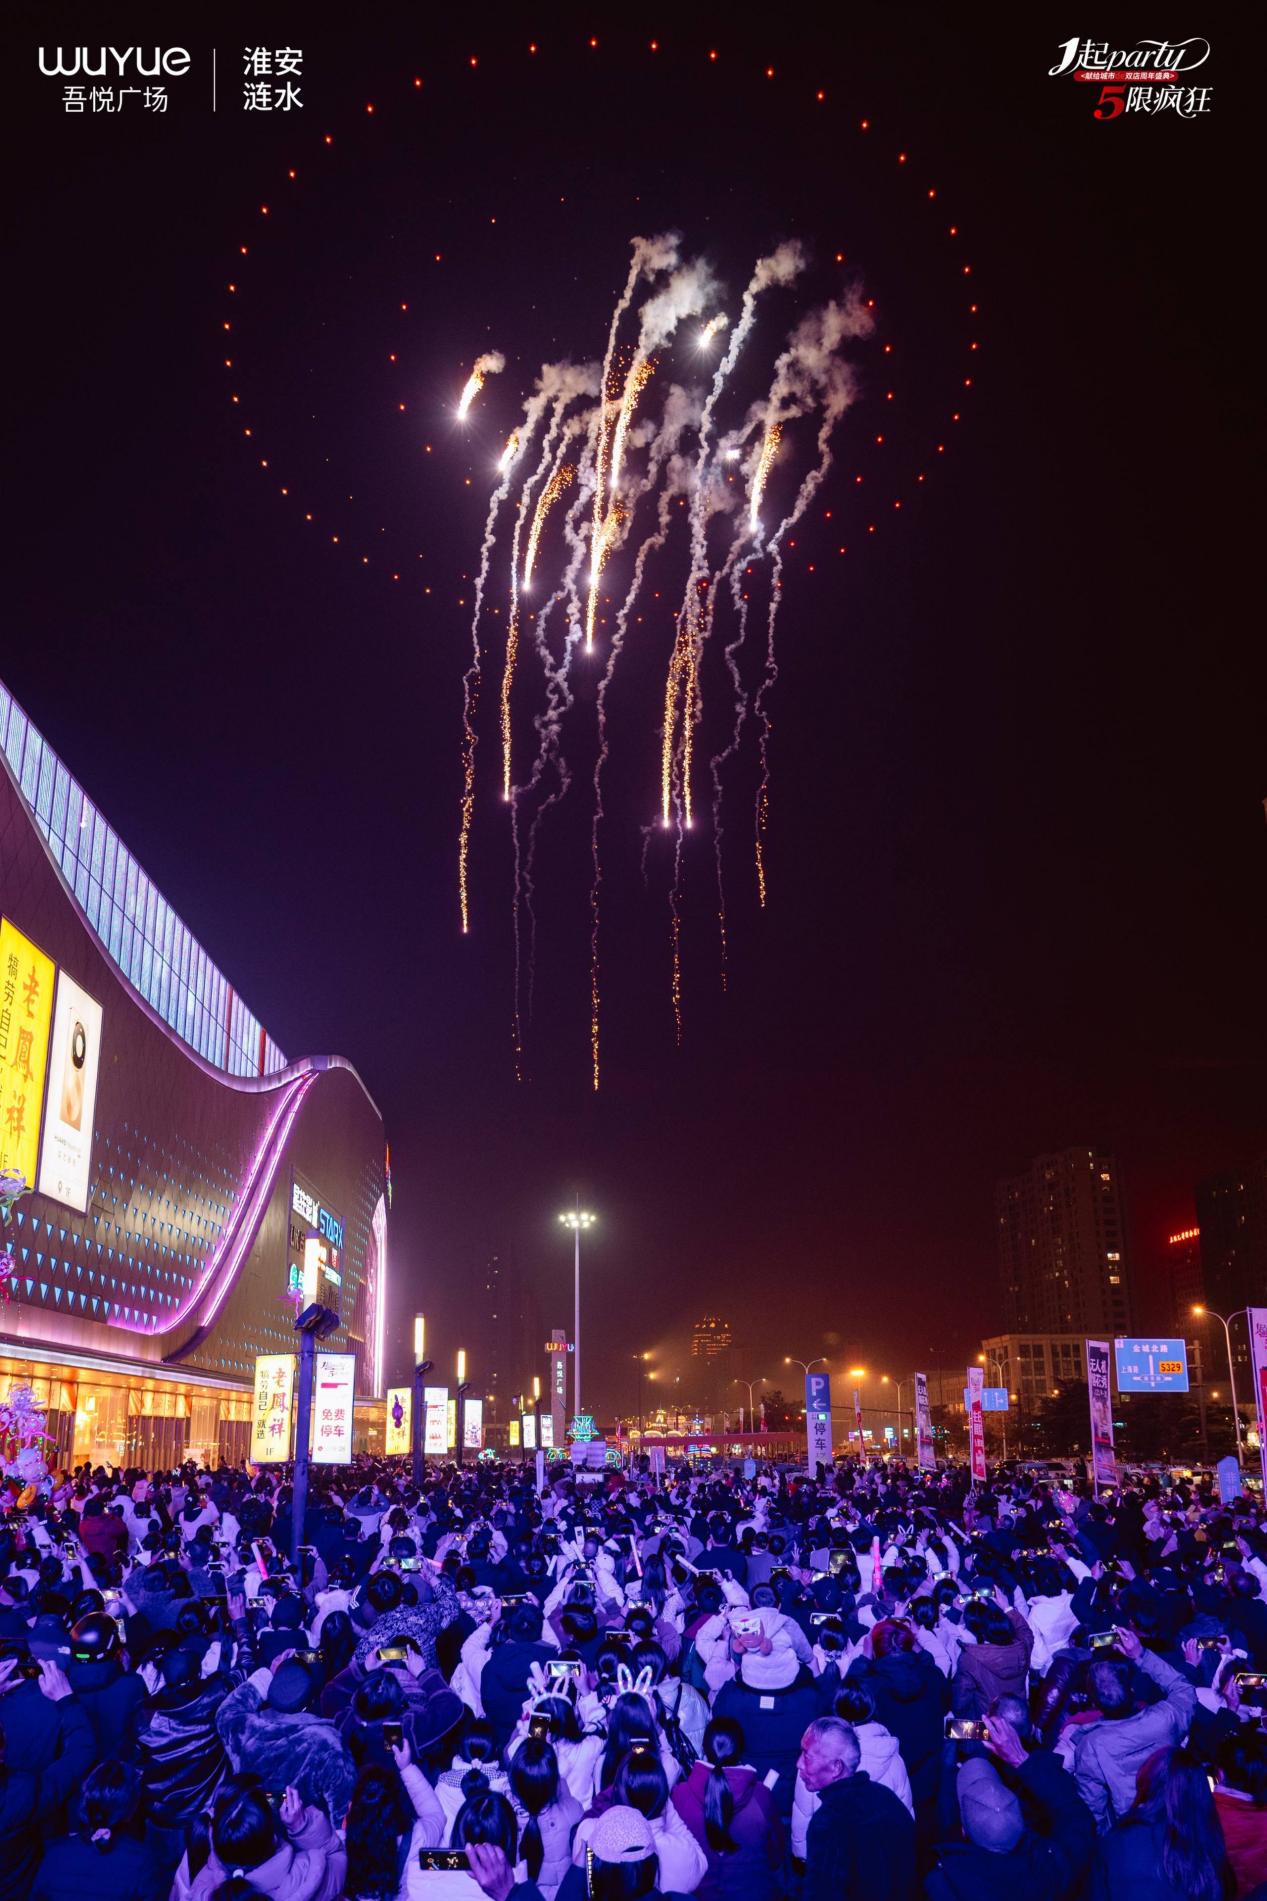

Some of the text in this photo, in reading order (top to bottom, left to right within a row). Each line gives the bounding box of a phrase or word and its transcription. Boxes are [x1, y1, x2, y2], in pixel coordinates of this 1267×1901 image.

[810, 1377, 825, 1396] P
[322, 1408, 345, 1421] 免费
[320, 1425, 344, 1437] 停车
